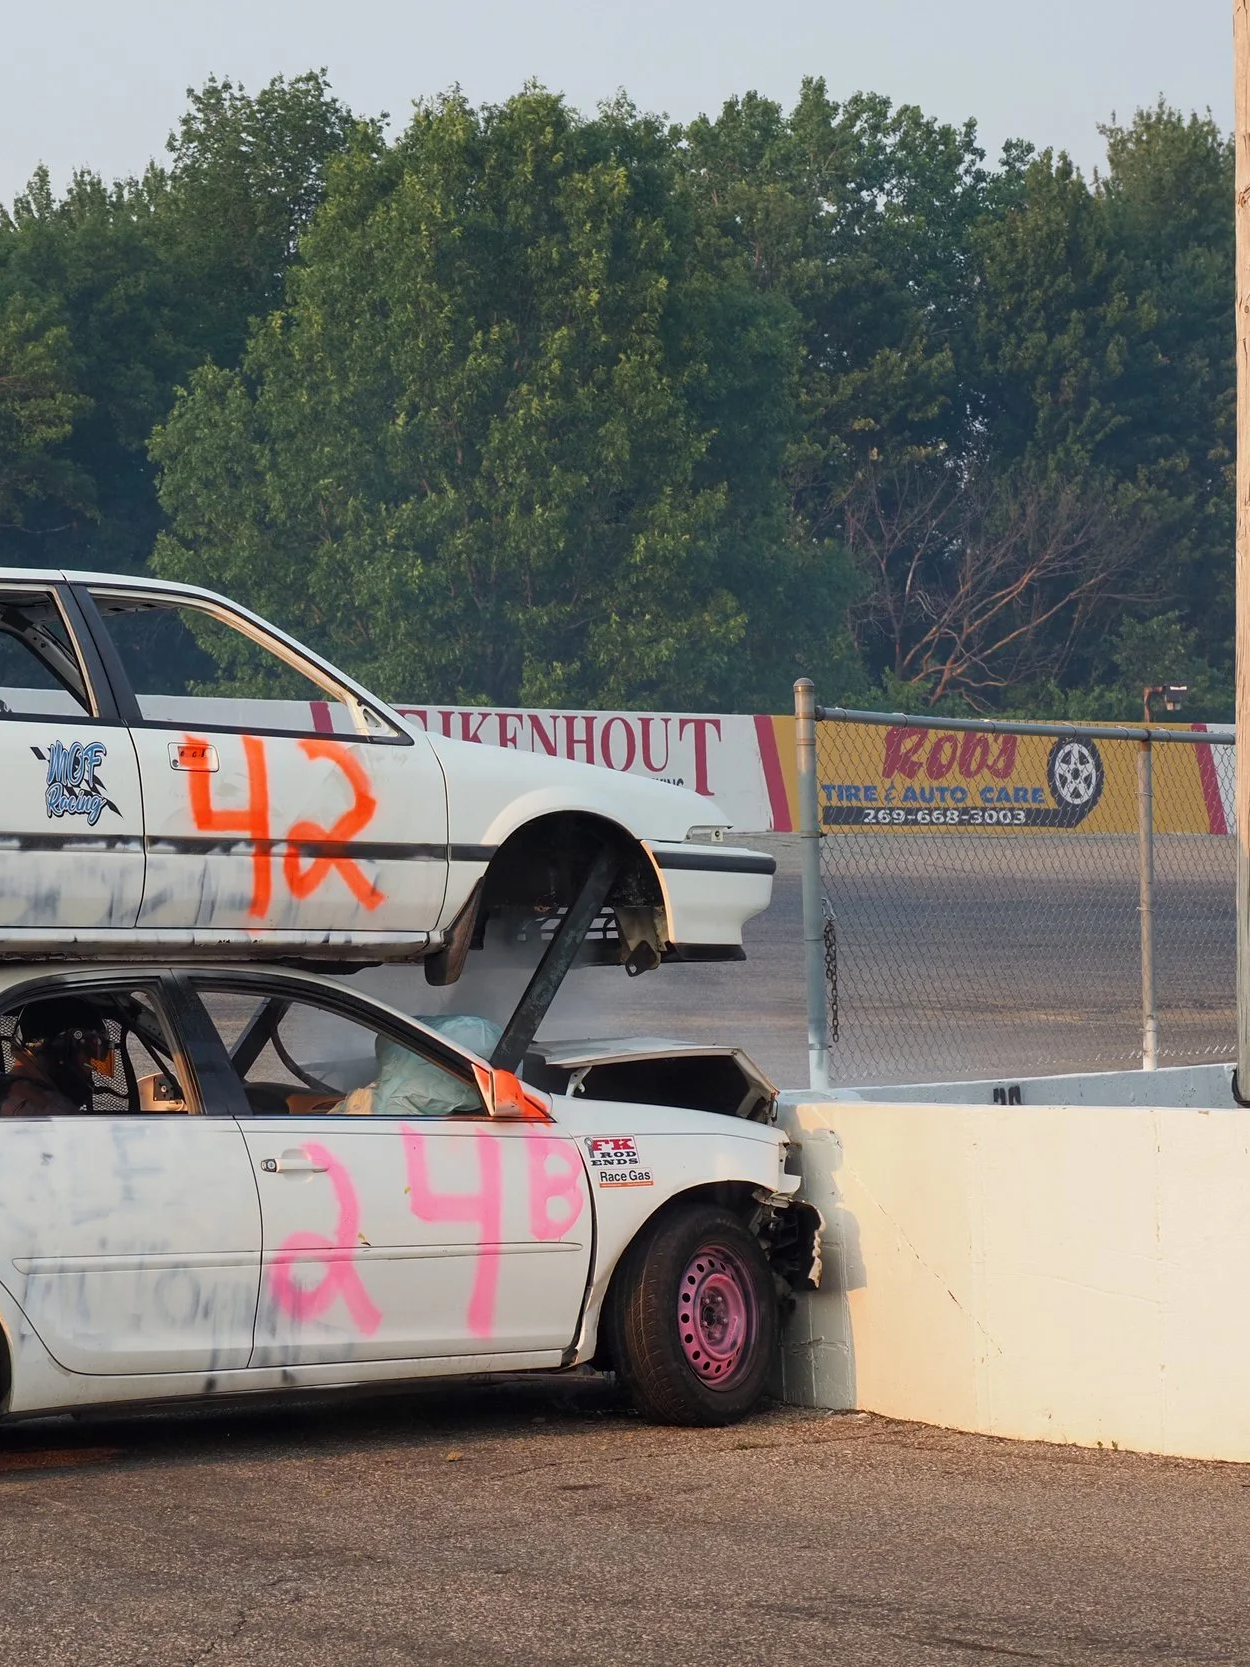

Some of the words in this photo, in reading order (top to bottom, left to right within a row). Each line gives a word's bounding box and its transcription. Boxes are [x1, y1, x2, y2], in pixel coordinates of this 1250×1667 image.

[395, 708, 722, 797] IKENHOUT
[821, 784, 878, 802] TIRE
[902, 786, 968, 803] AUTO
[980, 786, 1045, 804] CARE
[45, 783, 107, 826] Racing
[863, 808, 1027, 824] 269-668-3003
[181, 732, 386, 920] 42
[593, 1138, 635, 1151] FK
[590, 1158, 639, 1167] ENDS
[599, 1171, 628, 1182] Race
[628, 1169, 651, 1181] Gas
